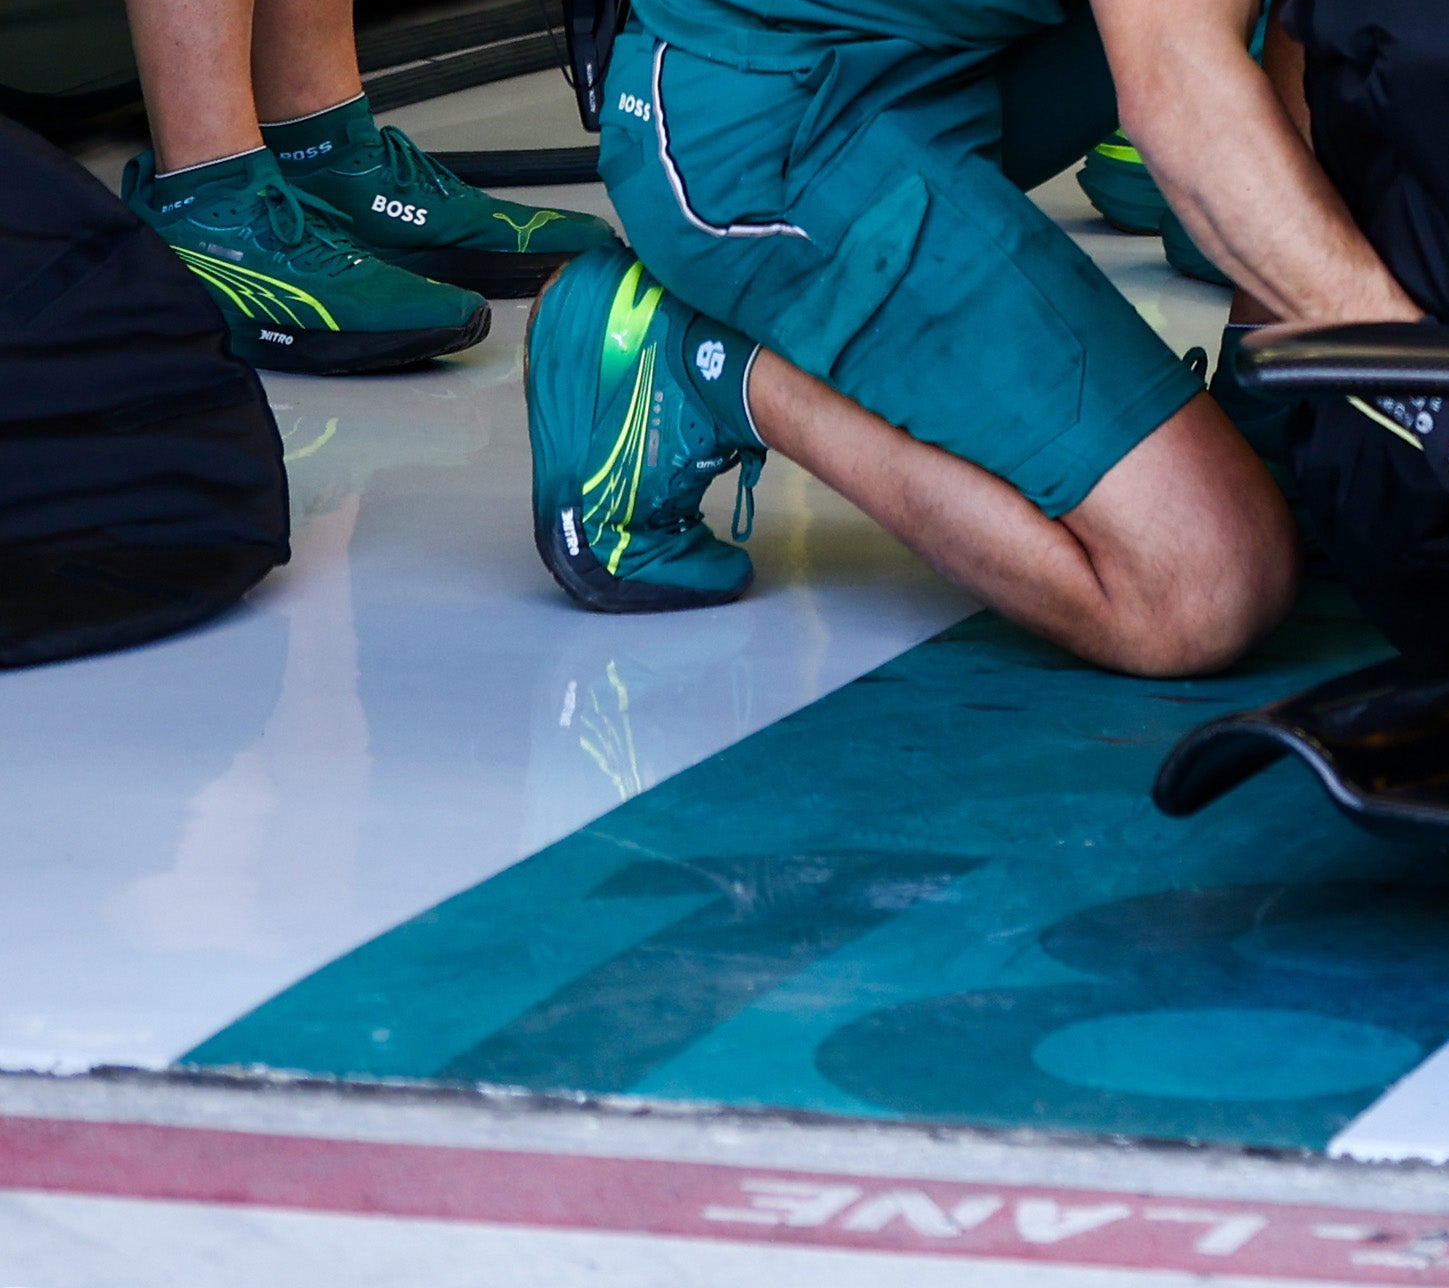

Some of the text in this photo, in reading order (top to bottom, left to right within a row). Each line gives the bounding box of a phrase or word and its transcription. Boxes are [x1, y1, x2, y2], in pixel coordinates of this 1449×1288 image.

[618, 92, 652, 122] BOSS
[370, 194, 429, 226] BOSS
[258, 328, 295, 347] NITRO
